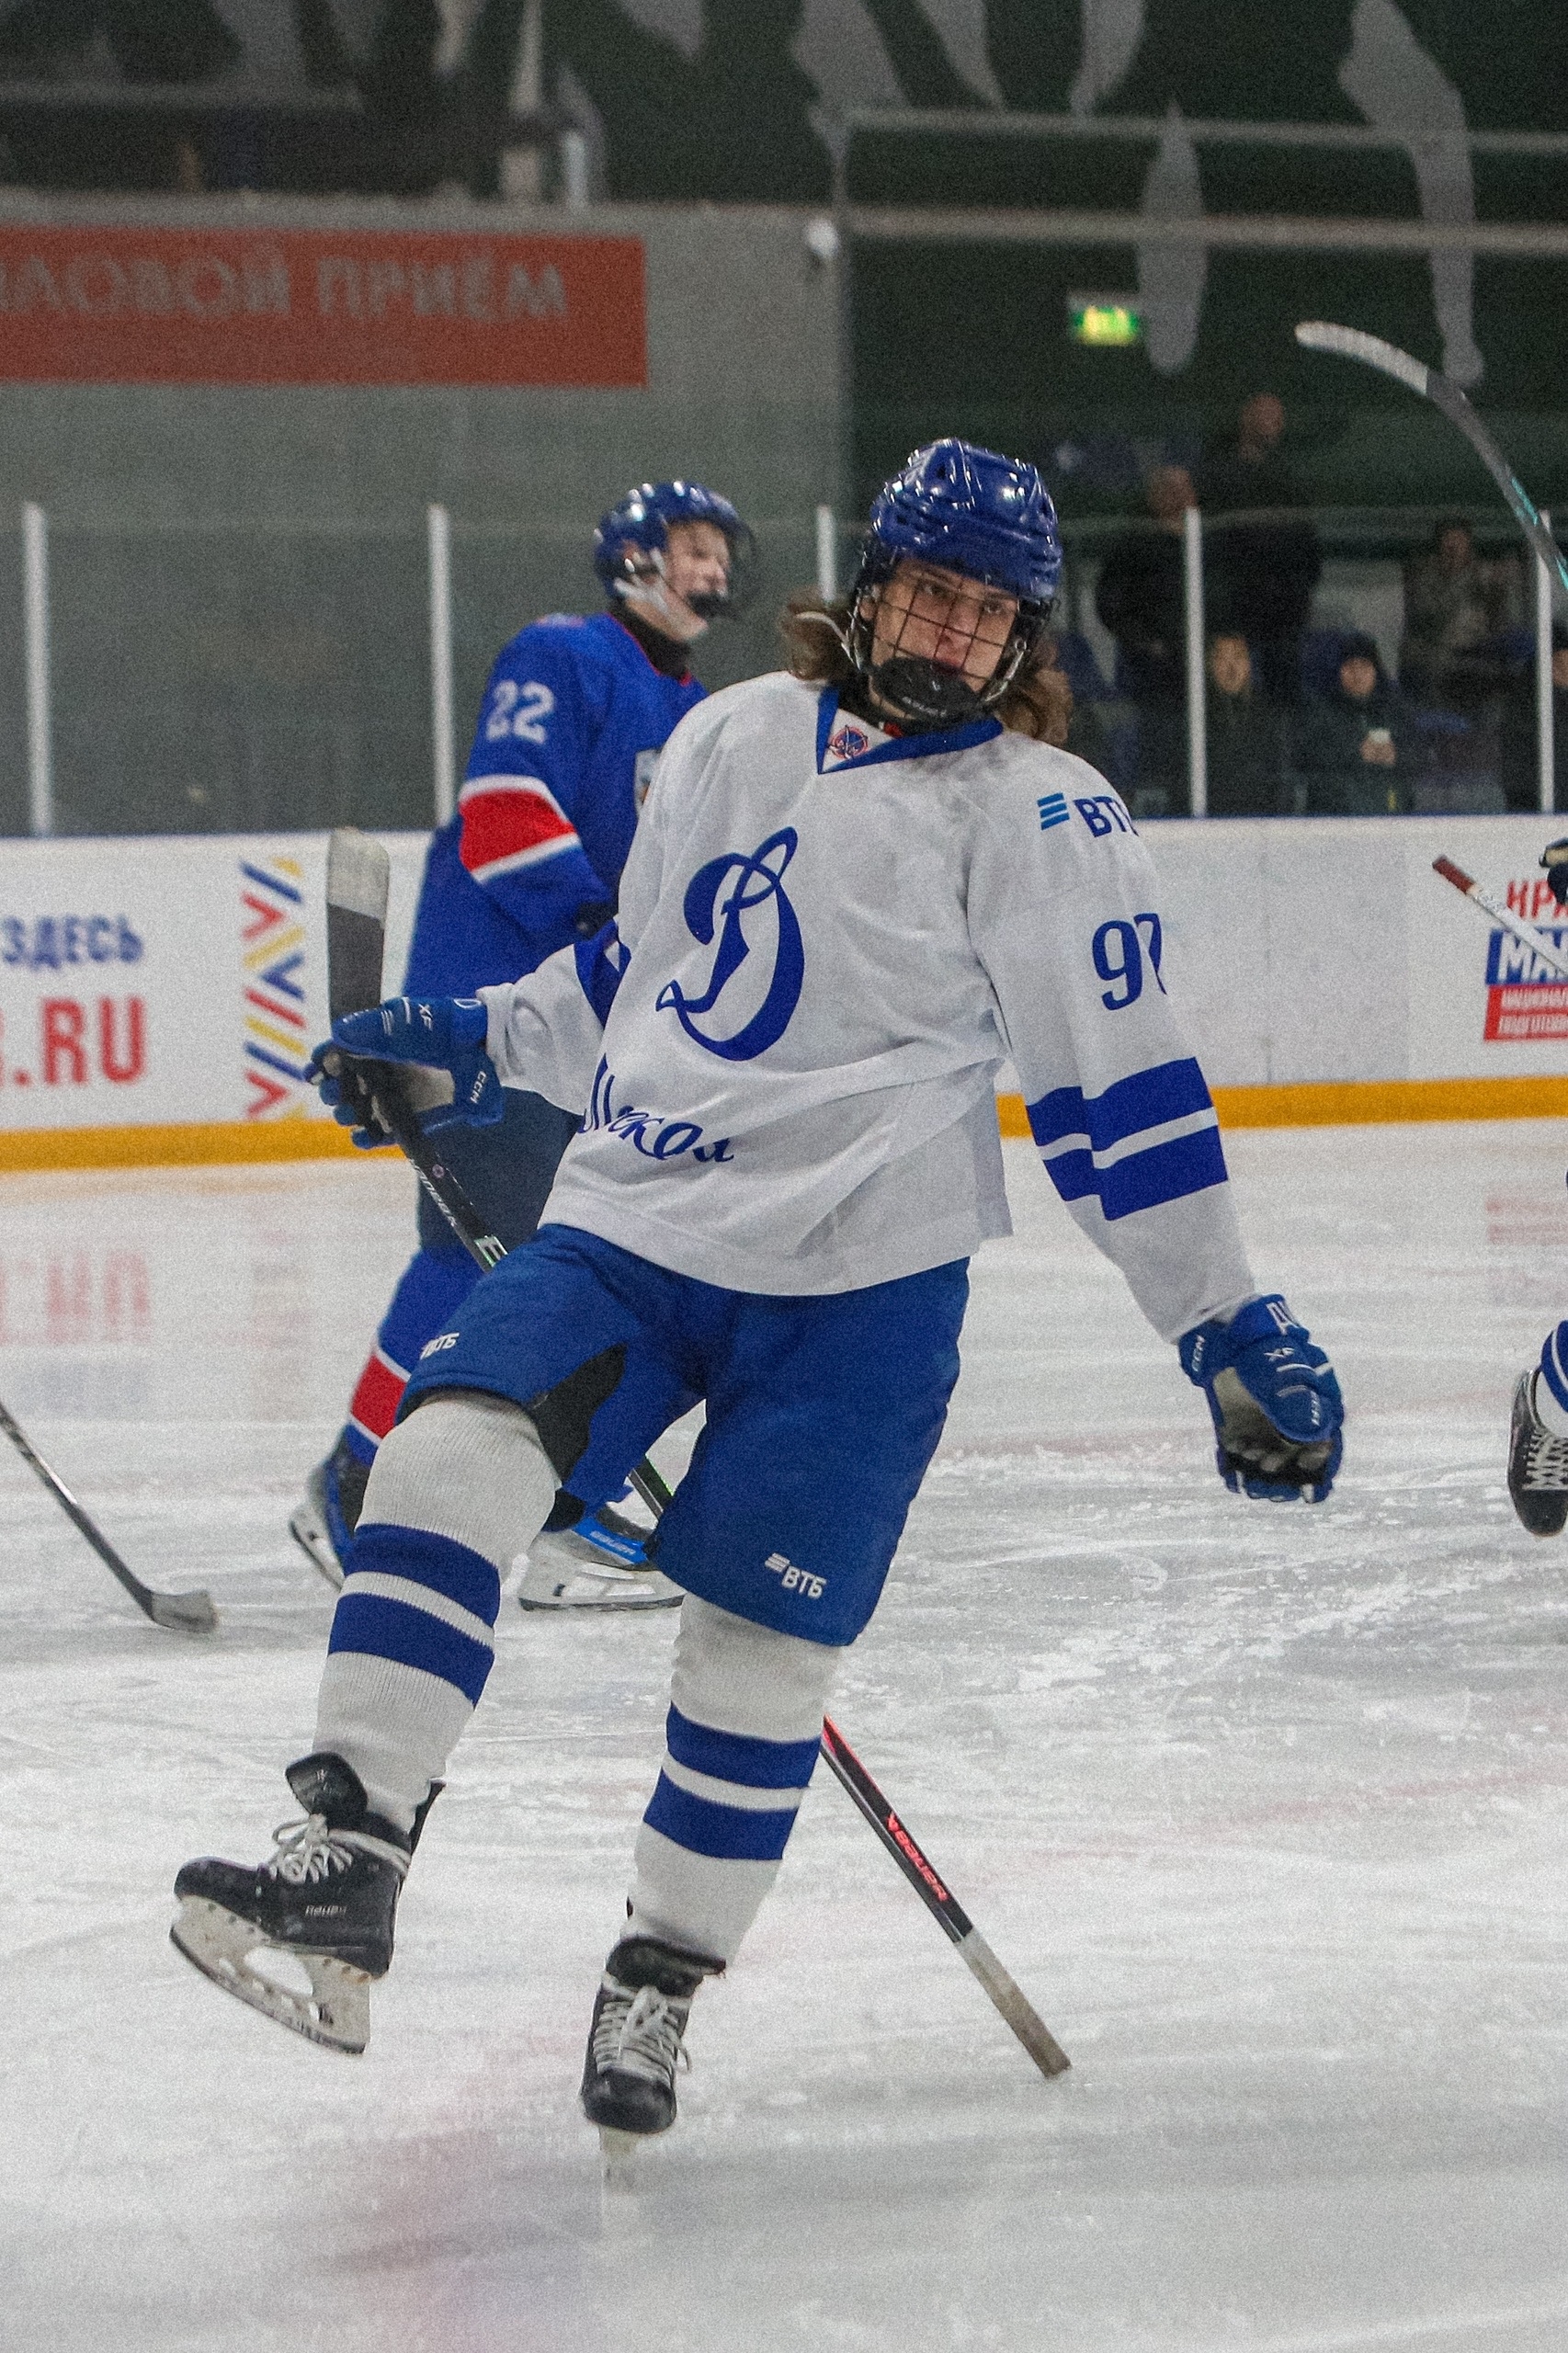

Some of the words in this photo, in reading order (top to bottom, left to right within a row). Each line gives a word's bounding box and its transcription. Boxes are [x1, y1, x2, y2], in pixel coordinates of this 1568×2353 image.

[486, 680, 554, 745] 22
[1, 914, 143, 971] ЗДЕСЬ
[1092, 913, 1167, 1011] 97
[0, 995, 145, 1086] .RU
[470, 1070, 487, 1105] CCM
[781, 1565, 827, 1598] ВТБ
